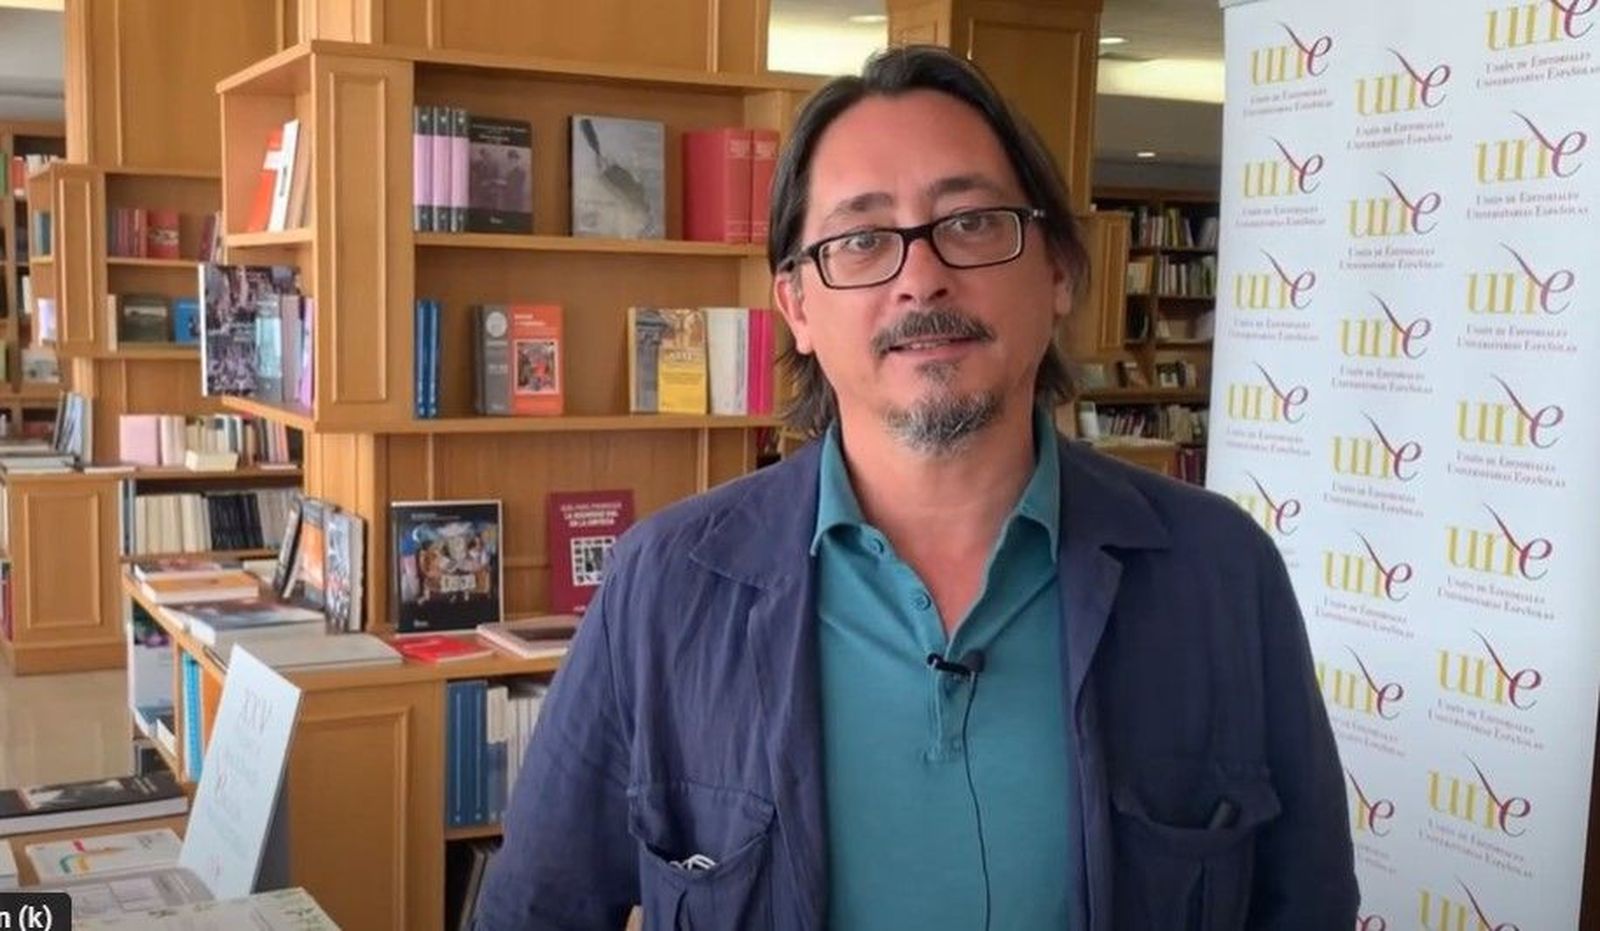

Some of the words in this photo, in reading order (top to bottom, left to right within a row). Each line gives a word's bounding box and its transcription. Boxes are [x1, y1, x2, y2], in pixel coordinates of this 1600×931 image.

[1250, 21, 1332, 86] une
[1355, 47, 1451, 116] une
[1243, 136, 1323, 198] une
[1476, 110, 1587, 184] une
[1348, 171, 1442, 237] une
[1233, 249, 1316, 310] une
[1465, 242, 1575, 316] une
[1339, 291, 1432, 359] une
[1227, 361, 1309, 425] une
[1457, 374, 1564, 449] une
[1331, 411, 1422, 481] une
[1321, 527, 1413, 602] une
[1446, 502, 1553, 581] une
[1436, 628, 1543, 710] une
[1427, 753, 1531, 838] une
